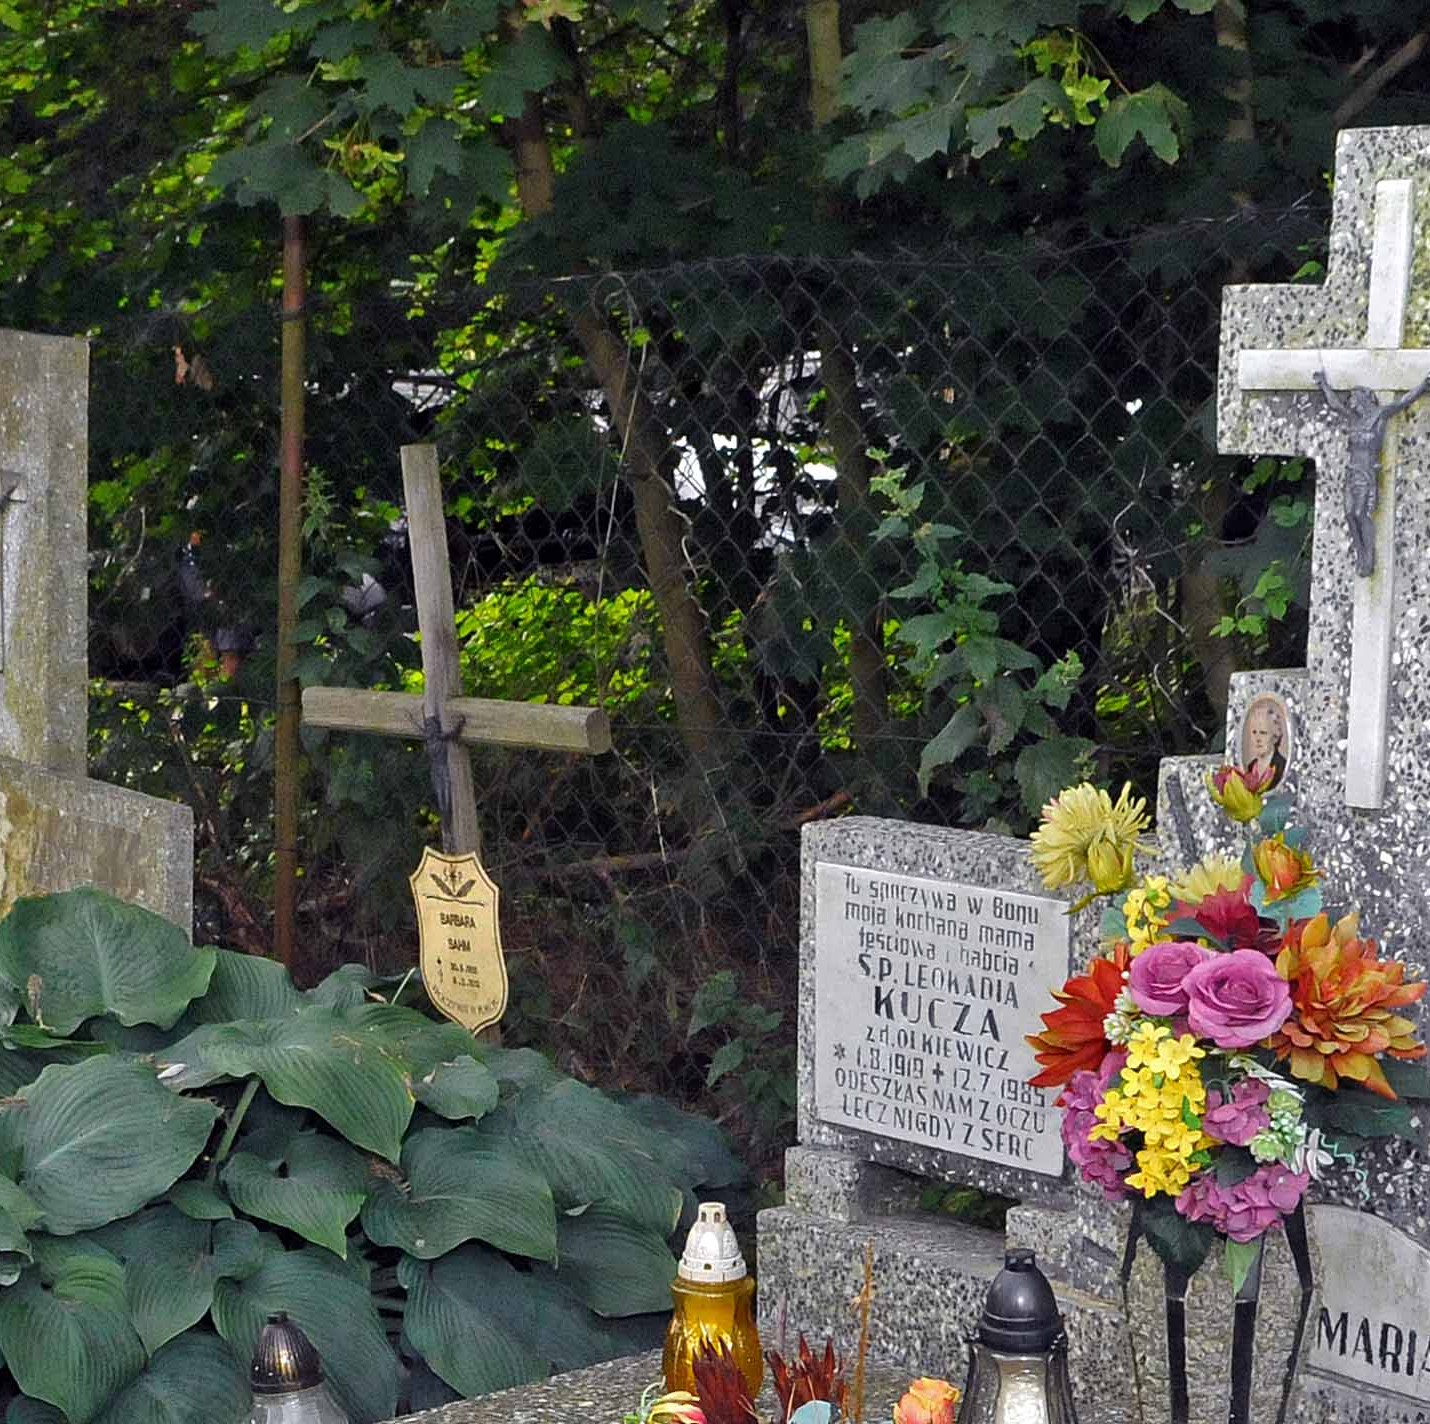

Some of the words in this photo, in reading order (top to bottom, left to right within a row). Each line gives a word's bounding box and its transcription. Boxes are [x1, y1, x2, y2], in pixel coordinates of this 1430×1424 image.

[845, 901, 887, 927] moja
[896, 906, 969, 941] kochana
[979, 924, 1035, 952] mama
[967, 896, 983, 916] w
[904, 962, 1020, 1009] LEOKADIA
[874, 986, 1001, 1042] KUCZA
[842, 1093, 888, 1125] LECZ
[893, 1106, 957, 1142] NIGDY
[963, 1122, 976, 1148] Z
[981, 1127, 1035, 1161] SERC
[932, 1089, 973, 1118] NAM
[979, 1099, 991, 1122] Z
[995, 1103, 1046, 1134] OCZU
